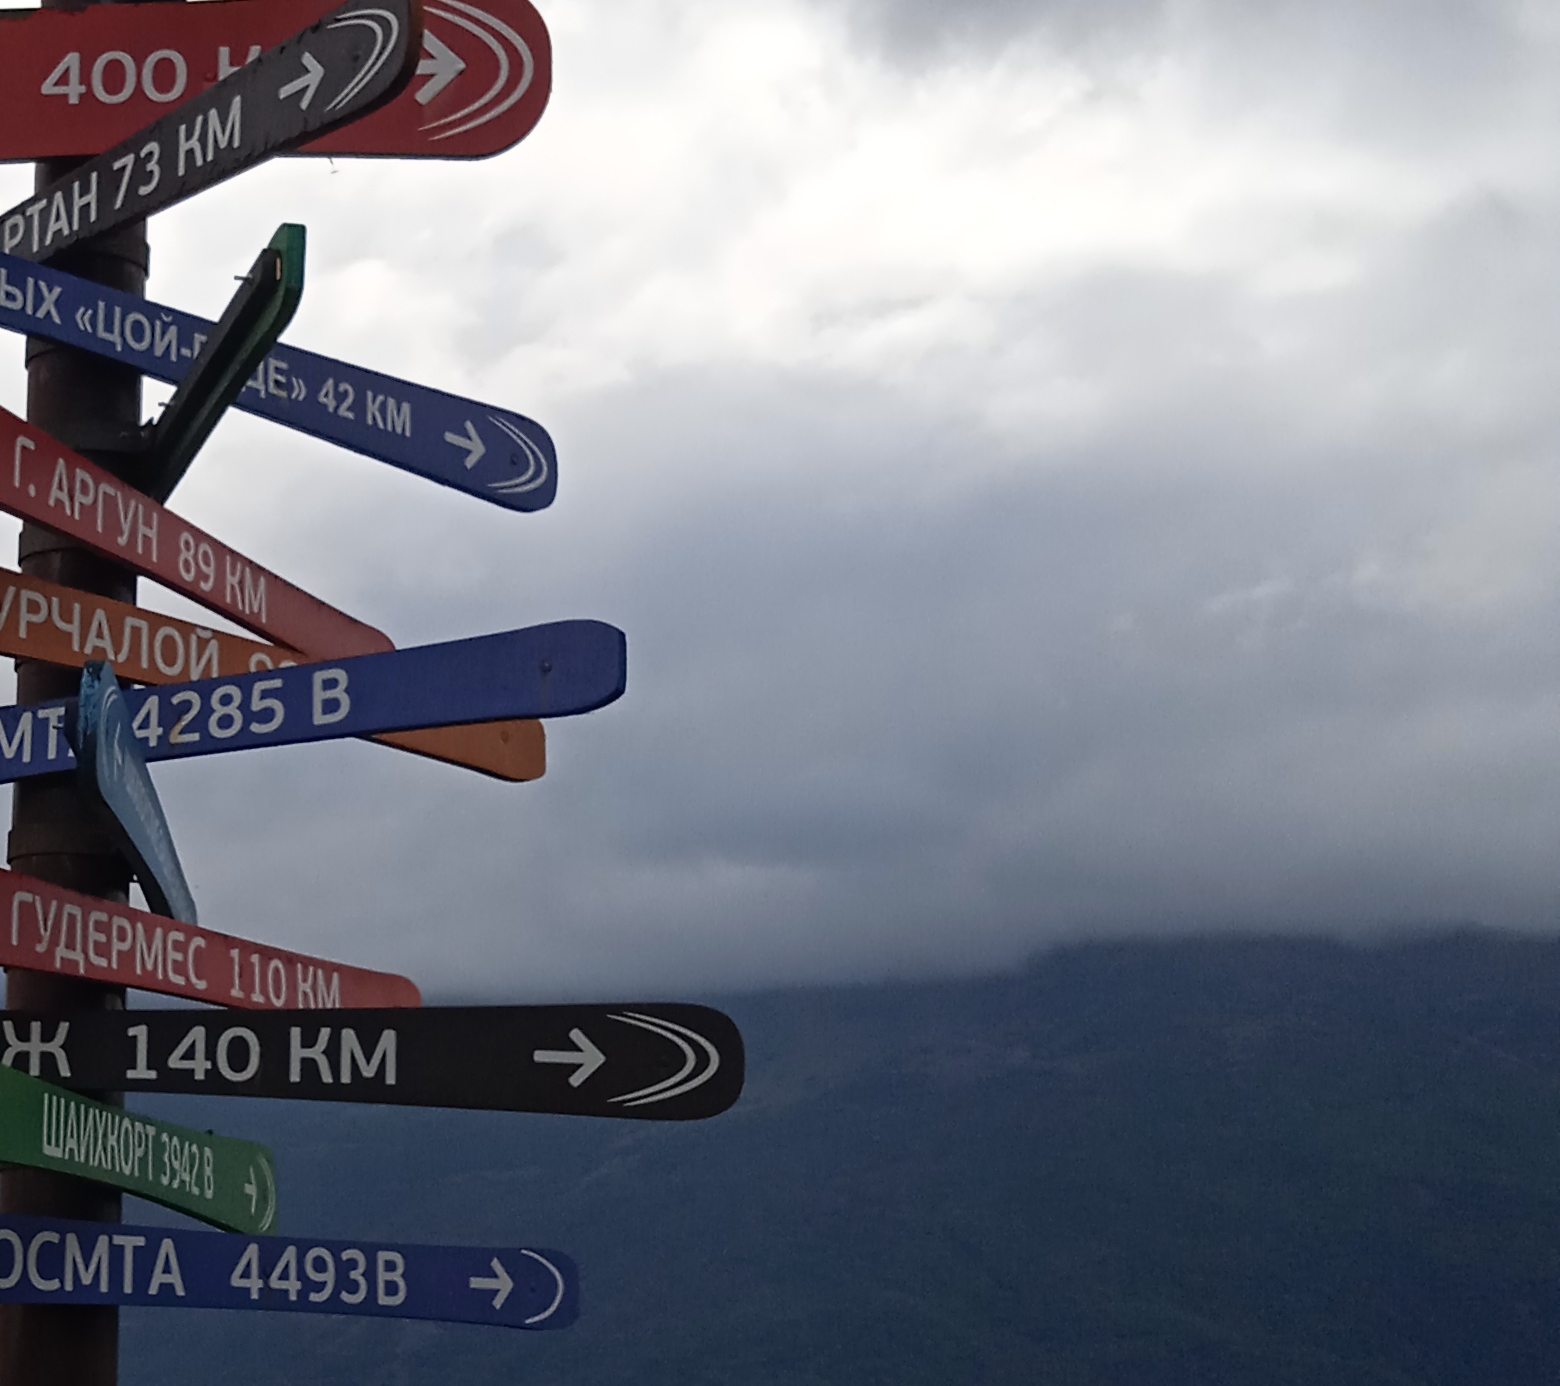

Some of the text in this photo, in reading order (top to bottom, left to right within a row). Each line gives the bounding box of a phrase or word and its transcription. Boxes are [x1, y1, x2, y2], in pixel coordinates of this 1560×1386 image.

[40, 48, 188, 105] 400
[112, 143, 161, 210] 73
[177, 95, 241, 177] КМ
[317, 377, 356, 421] 42
[365, 389, 412, 438] КМ
[13, 435, 268, 624] Г. АРГУН 89 КМ
[131, 677, 286, 749] 4285
[312, 667, 352, 725] В
[11, 890, 208, 991] ГУДЕРМЕС
[228, 947, 287, 1007] 110
[297, 961, 341, 1009] КМ
[125, 1023, 261, 1082] 140
[287, 1025, 399, 1086] КМ
[159, 1131, 201, 1197] 3942
[230, 1241, 408, 1307] 4493В
